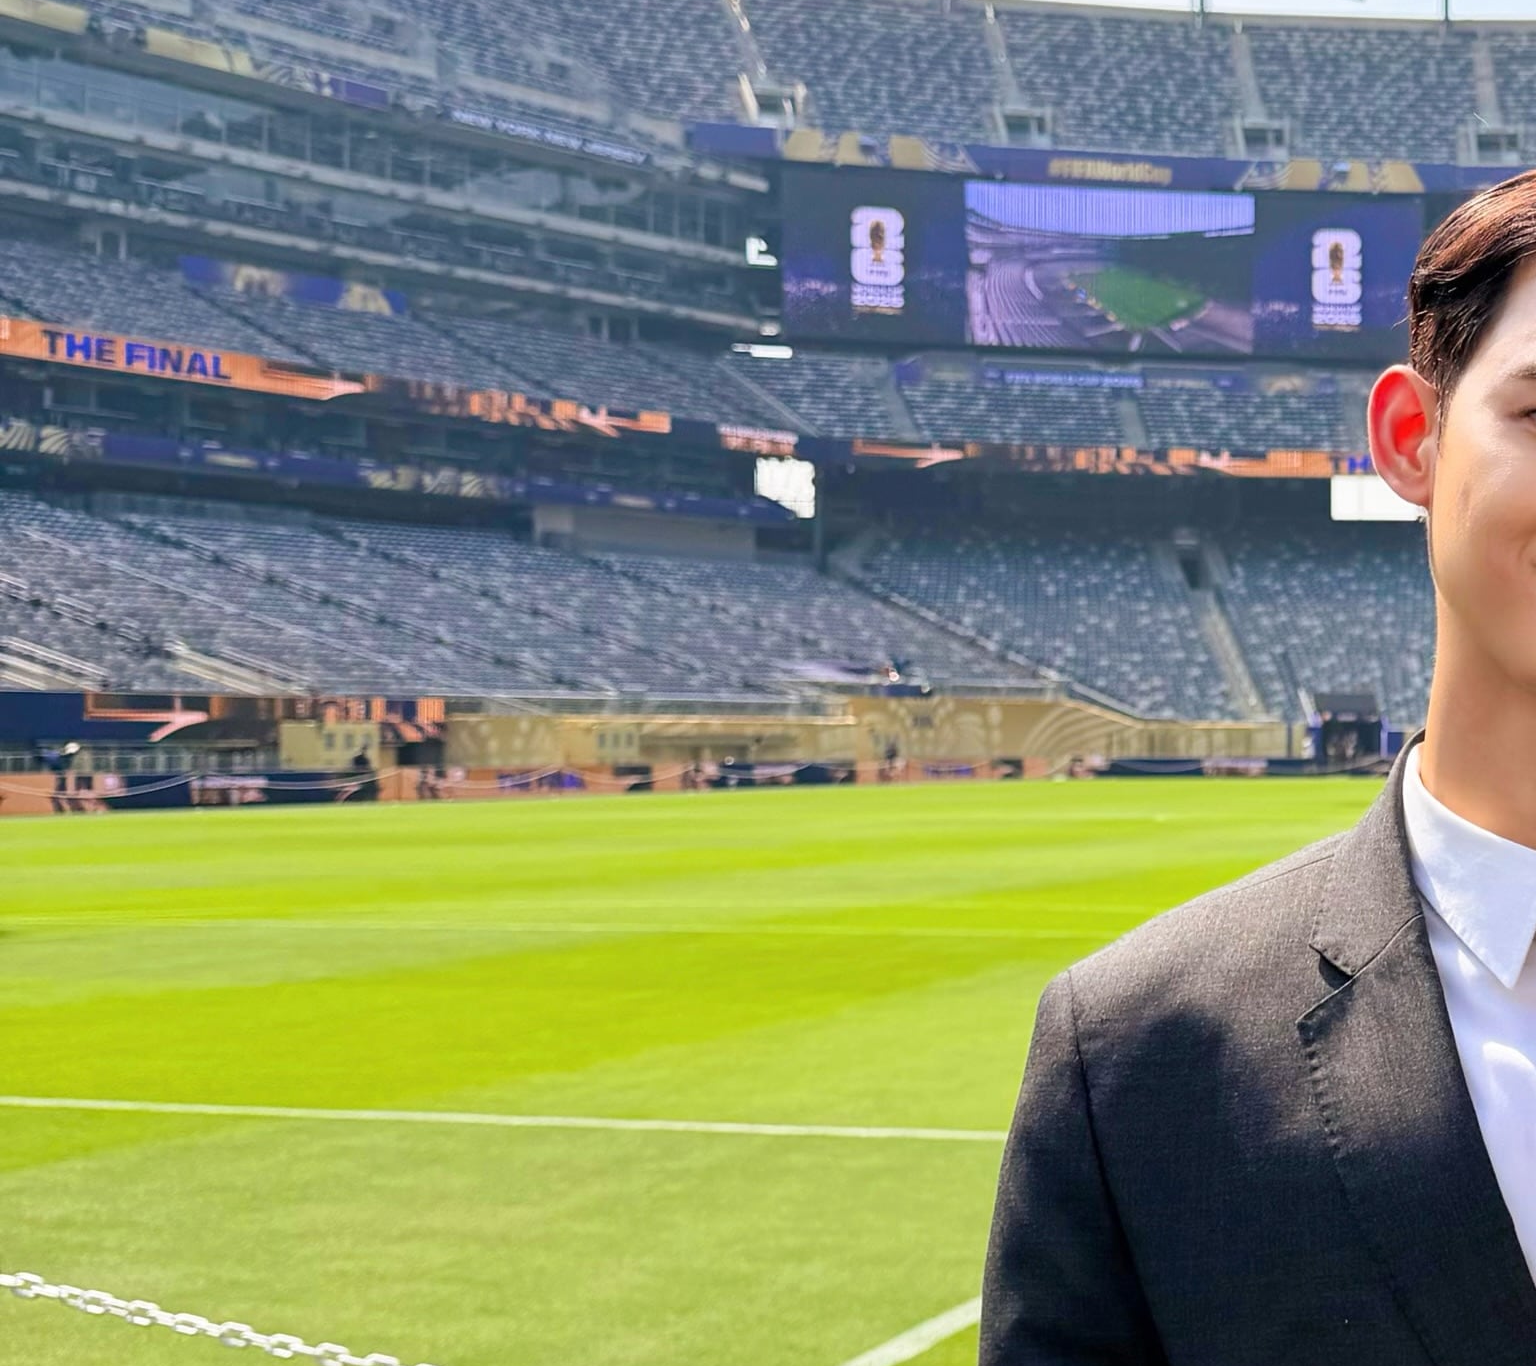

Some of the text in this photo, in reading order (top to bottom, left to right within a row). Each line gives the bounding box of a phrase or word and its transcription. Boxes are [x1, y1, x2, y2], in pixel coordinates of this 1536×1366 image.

[42, 329, 231, 380] THE FINAL
[1329, 453, 1374, 474] TH
